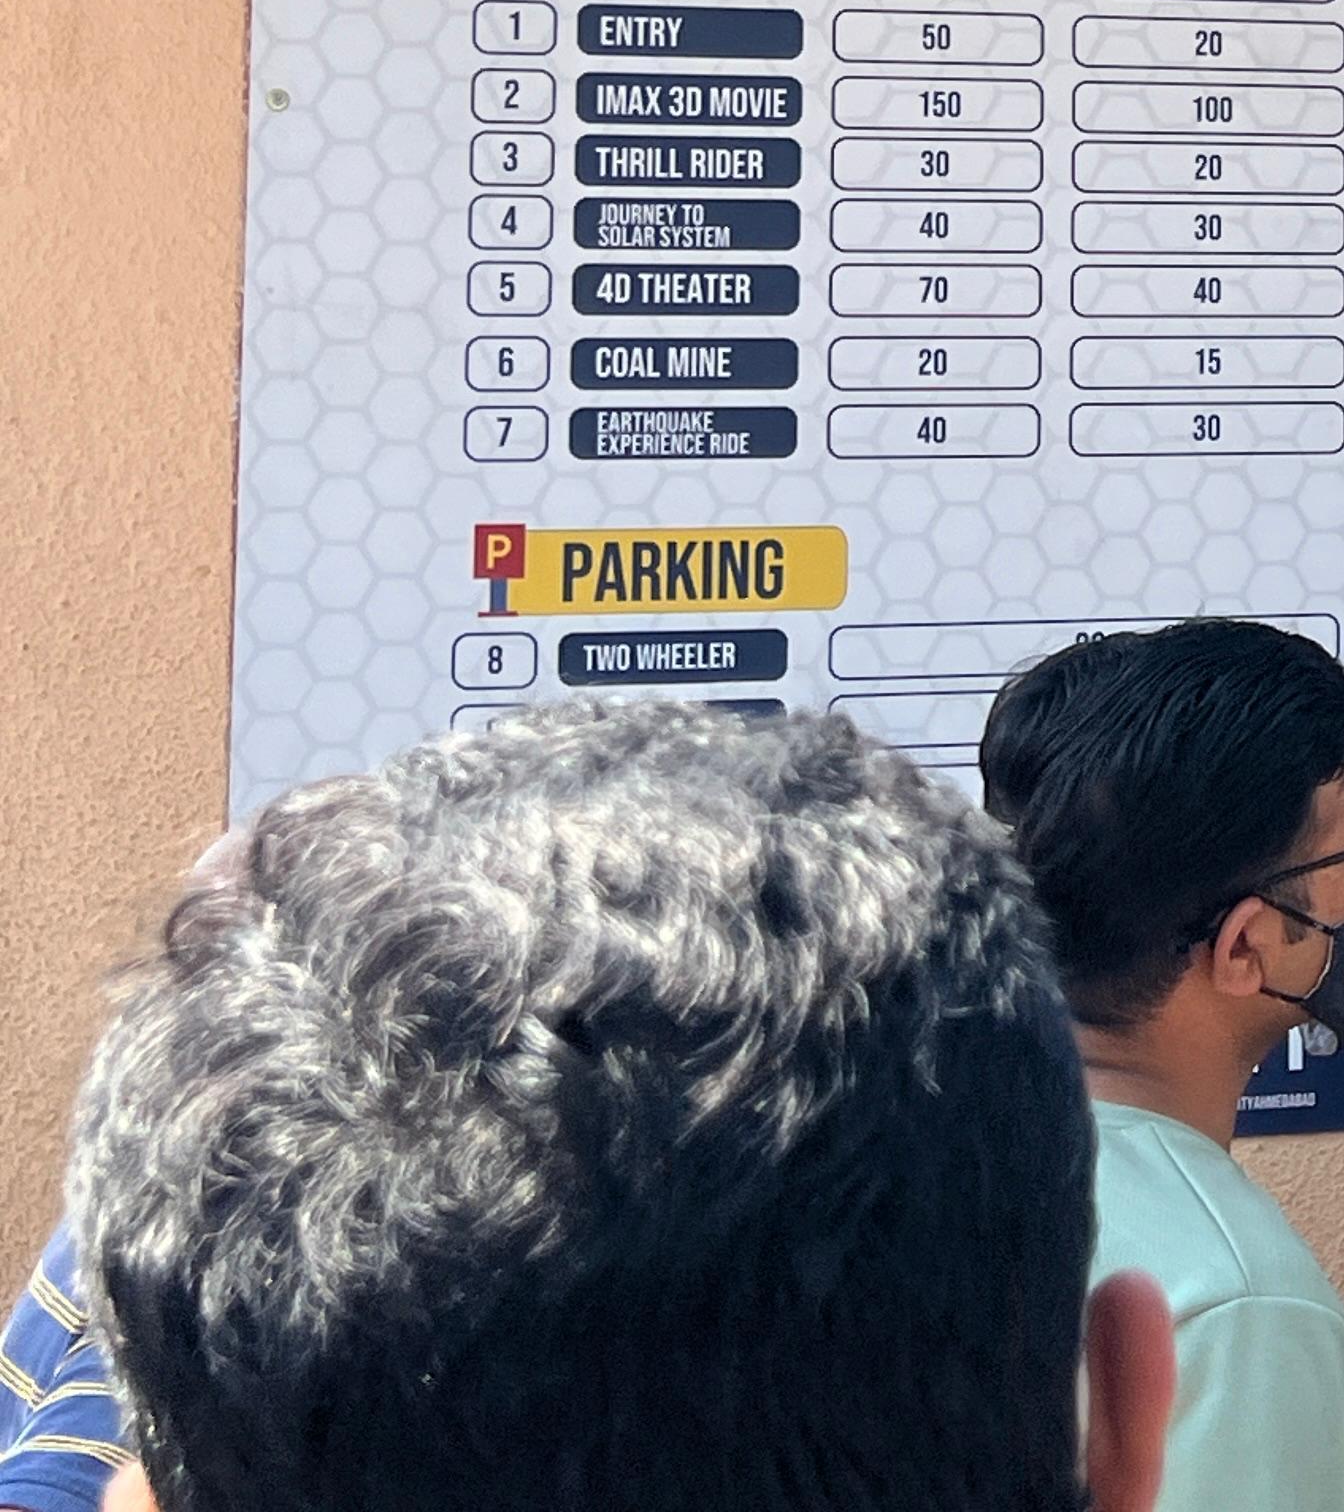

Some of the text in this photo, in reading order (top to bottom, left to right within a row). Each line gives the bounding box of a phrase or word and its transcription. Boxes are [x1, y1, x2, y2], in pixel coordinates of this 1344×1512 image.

[508, 11, 521, 40] 1
[601, 16, 683, 48] ENTRY
[921, 24, 951, 51] 50
[1195, 30, 1223, 57] 20
[503, 80, 519, 109] 2
[597, 85, 787, 118] IMAX 3D MOVIE
[918, 91, 961, 118] 150
[1193, 97, 1233, 123] 100
[502, 142, 518, 172] 3
[596, 147, 764, 180] THRILL RIDER
[920, 150, 950, 177] 30
[1195, 154, 1222, 181] 20
[501, 206, 518, 236] 4
[598, 204, 704, 225] JOURNEY TO
[919, 211, 949, 239] 40
[1194, 214, 1222, 241] 30
[598, 226, 731, 248] SOLAR SYSTEM
[500, 272, 516, 302] 5
[596, 273, 751, 304] 4D THEATER
[919, 276, 949, 304] 70
[1193, 277, 1222, 304] 40
[498, 347, 514, 377] 6
[595, 347, 732, 378] COAL MINE
[918, 349, 948, 376] 20
[1195, 349, 1222, 376] 15
[497, 417, 512, 447] 7
[598, 411, 714, 434] EARTHQUAKE
[917, 416, 947, 443] 40
[1193, 415, 1221, 441] 30
[598, 433, 750, 456] EXPERIENCE RIDE
[487, 534, 512, 570] P
[562, 539, 785, 603] PARKING
[487, 646, 503, 674] 8
[584, 642, 736, 672] TWO WHEELER
[1237, 1092, 1316, 1111] ITYAHMEDABAD
